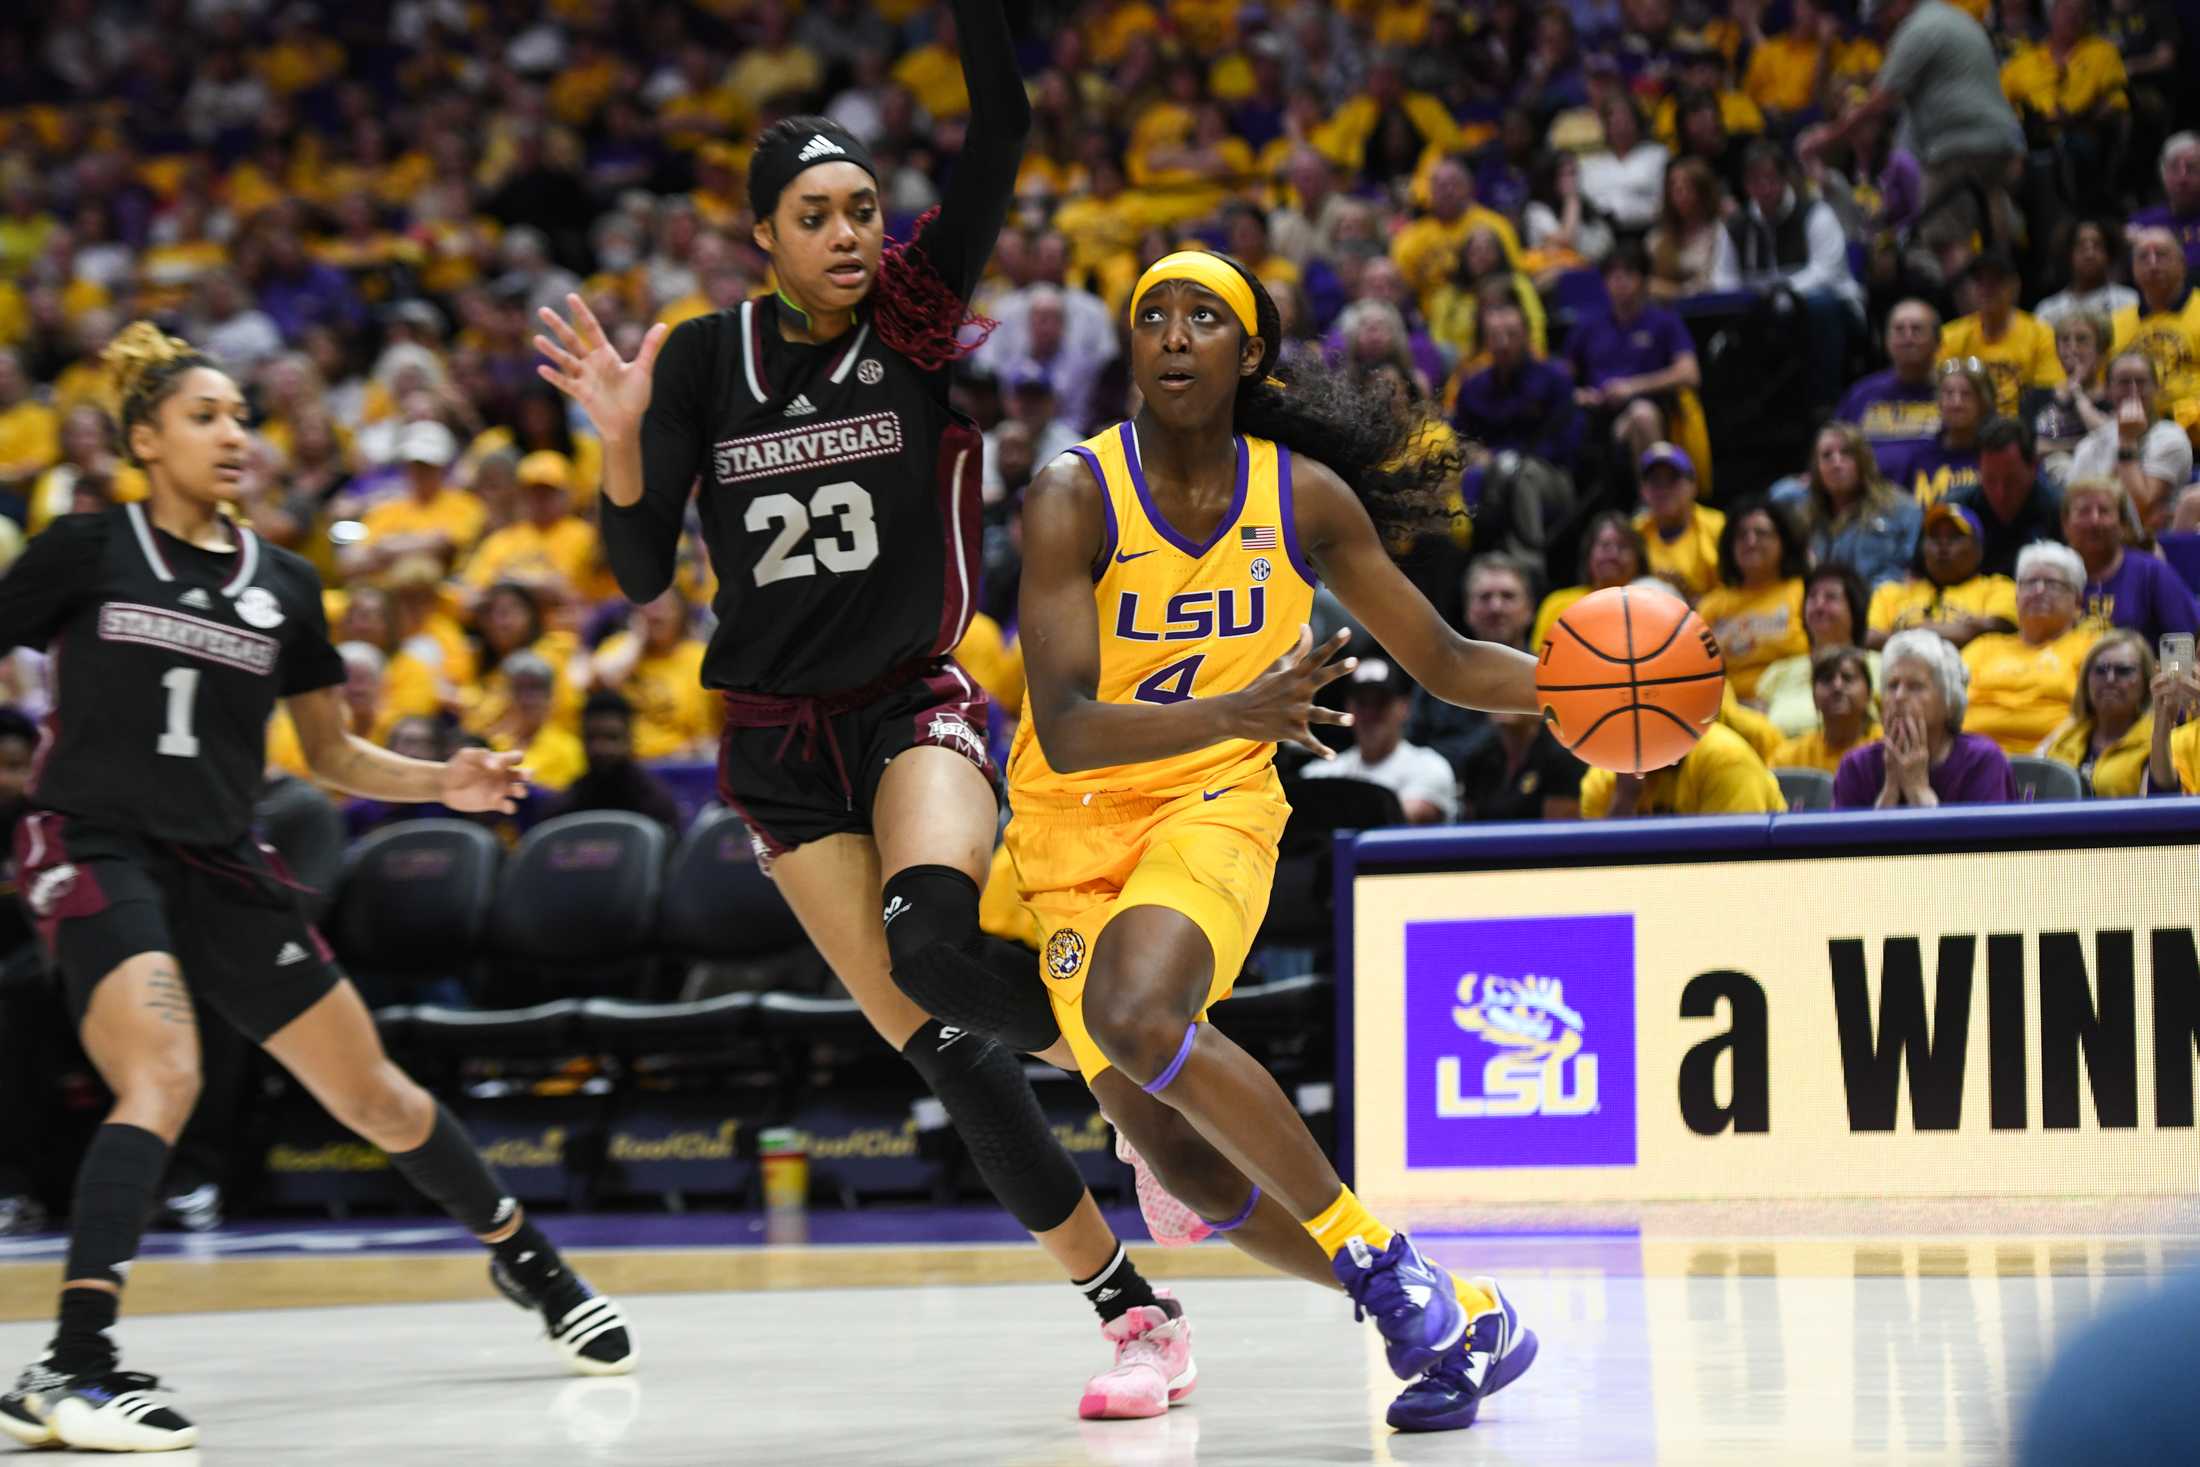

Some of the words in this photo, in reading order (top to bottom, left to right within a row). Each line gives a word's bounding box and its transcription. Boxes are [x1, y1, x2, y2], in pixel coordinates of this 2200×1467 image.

[714, 419, 896, 476] STARKVEGAS
[743, 480, 880, 588] 23
[1250, 558, 1271, 581] SEC
[1115, 584, 1265, 642] LSU
[1132, 653, 1208, 706] 4
[156, 666, 201, 758] 1
[1678, 967, 1769, 1137] a
[1436, 1052, 1599, 1119] LSU
